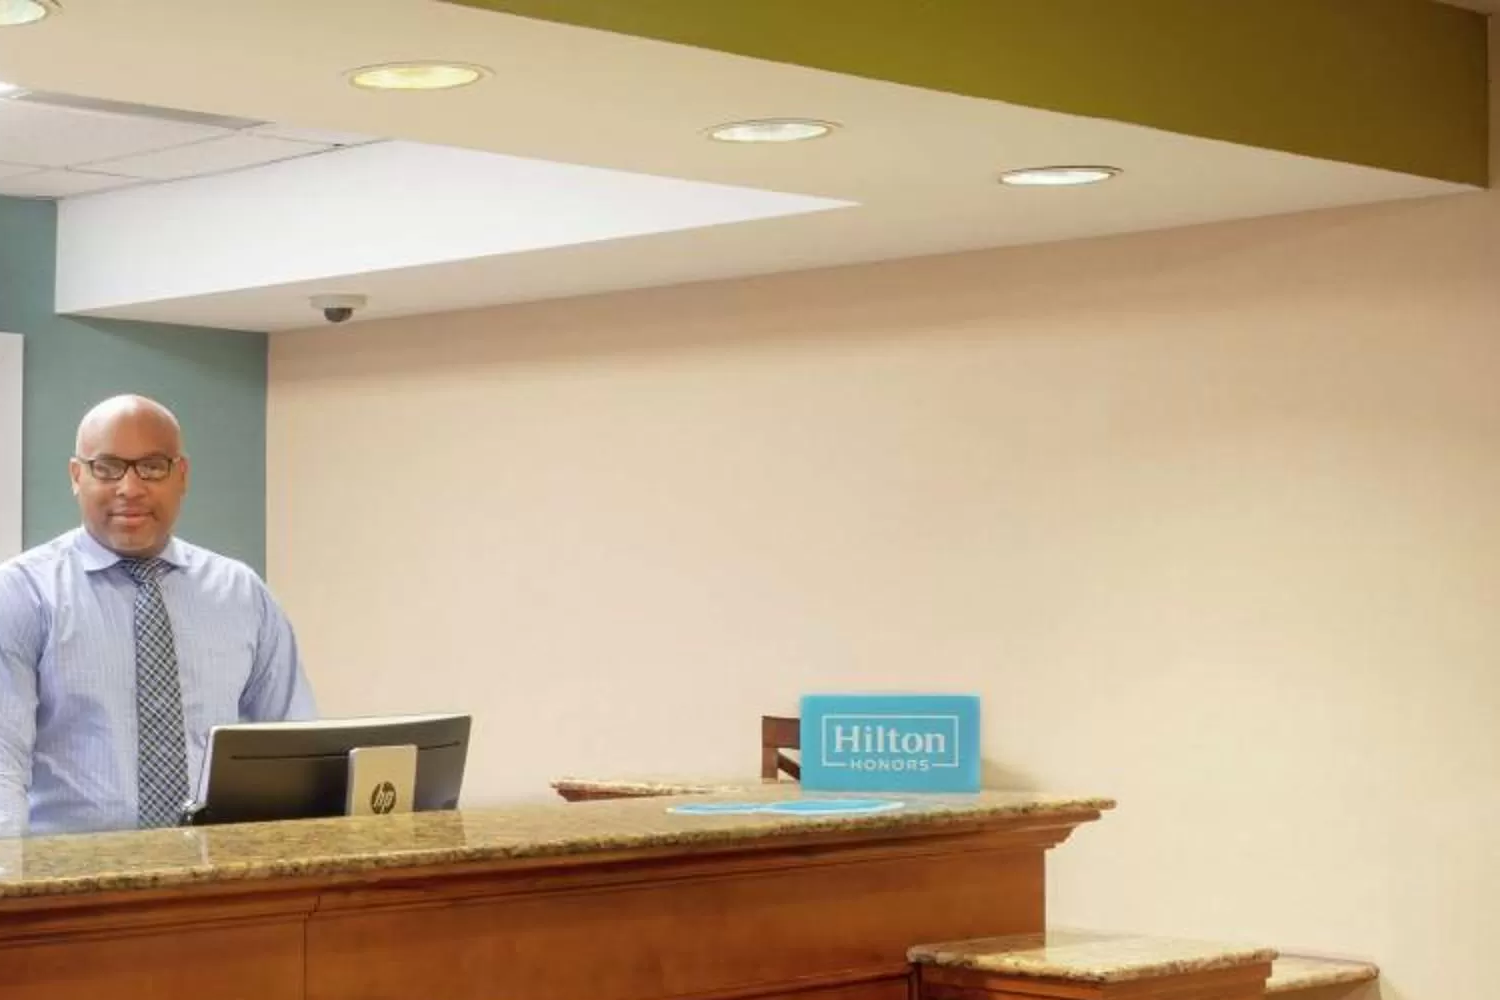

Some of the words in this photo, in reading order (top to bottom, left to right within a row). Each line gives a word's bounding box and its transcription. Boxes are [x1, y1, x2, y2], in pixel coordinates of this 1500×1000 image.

[834, 725, 946, 754] Hilton
[850, 759, 930, 772] HONORS
[373, 783, 395, 813] hp
